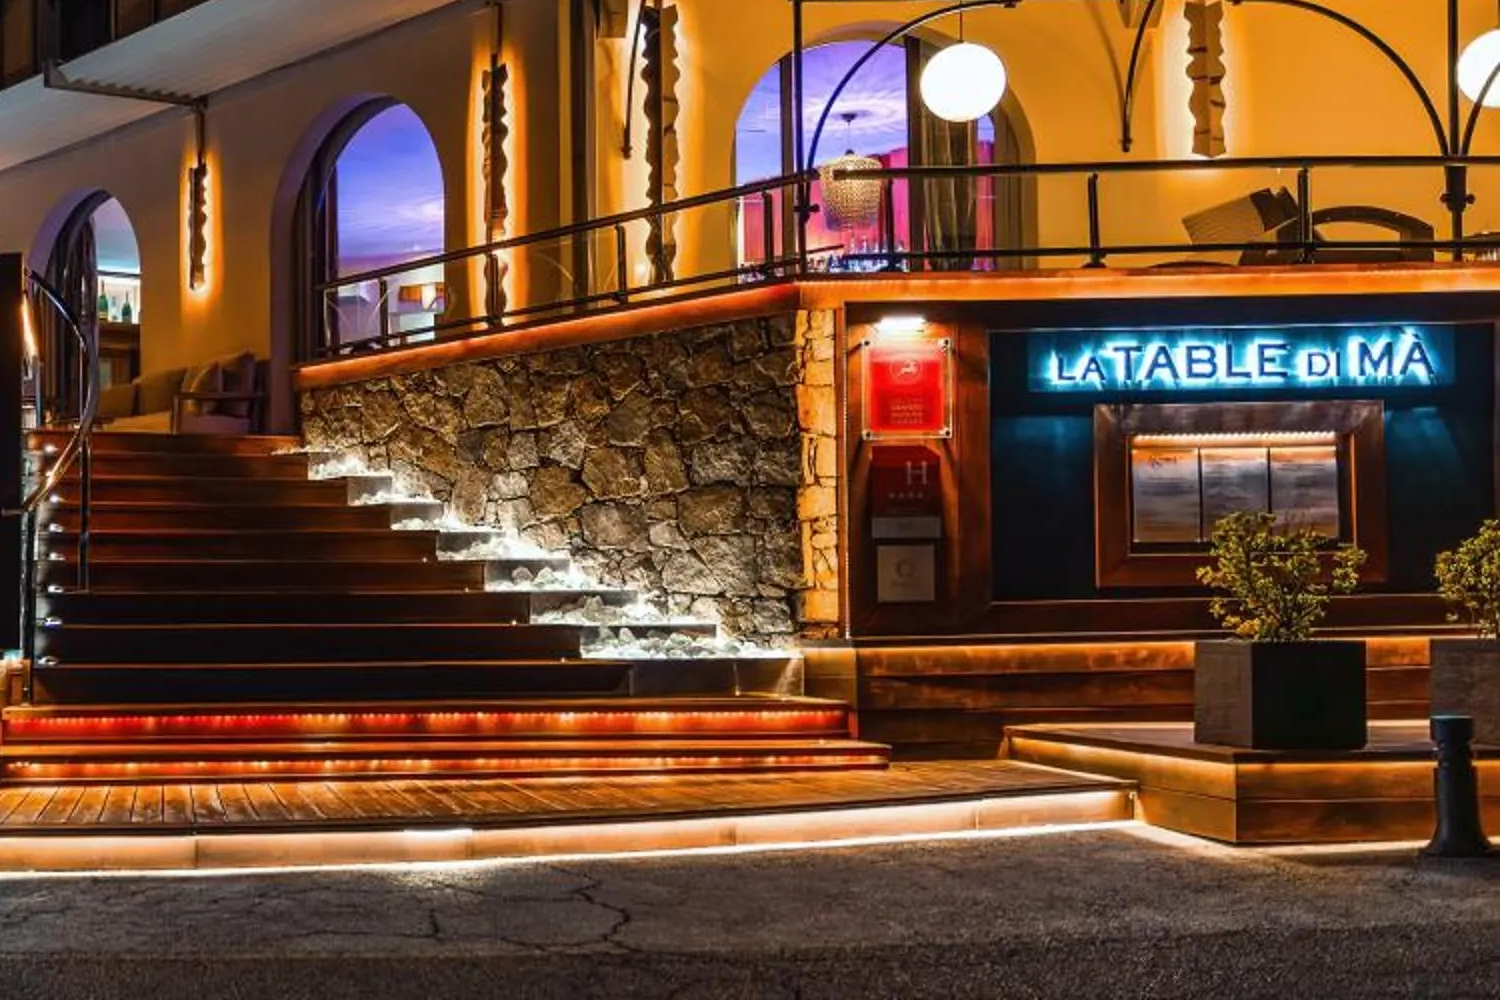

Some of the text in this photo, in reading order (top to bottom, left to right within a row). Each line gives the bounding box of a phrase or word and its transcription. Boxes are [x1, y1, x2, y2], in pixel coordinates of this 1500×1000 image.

[1057, 333, 1436, 381] LA TABLE DI MÀ
